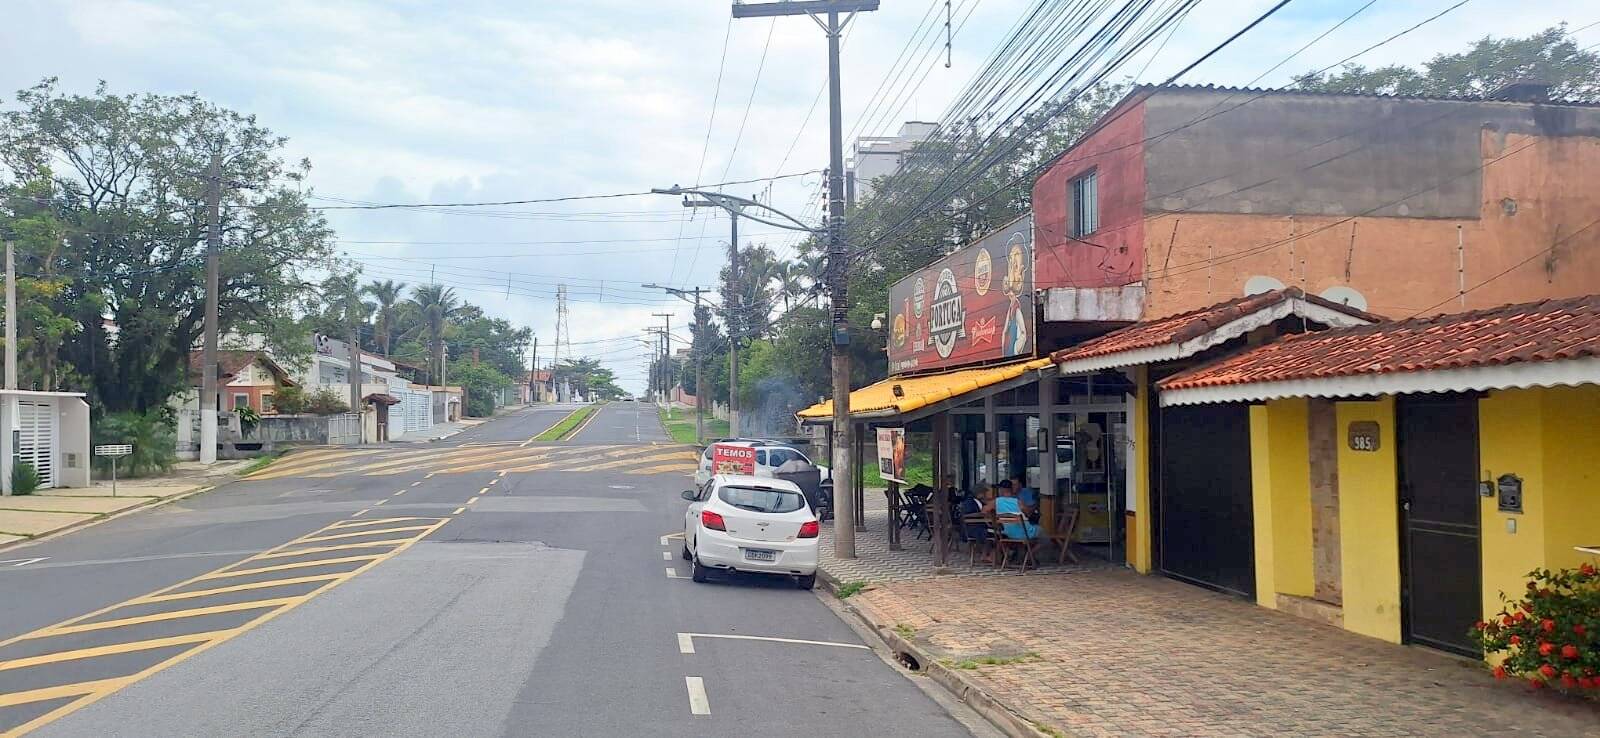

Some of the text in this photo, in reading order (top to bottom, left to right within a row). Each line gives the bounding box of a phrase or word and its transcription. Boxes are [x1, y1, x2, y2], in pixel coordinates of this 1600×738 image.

[931, 299, 961, 328] PORTUGA
[1354, 436, 1371, 449] 985
[717, 448, 753, 458] TEMOS
